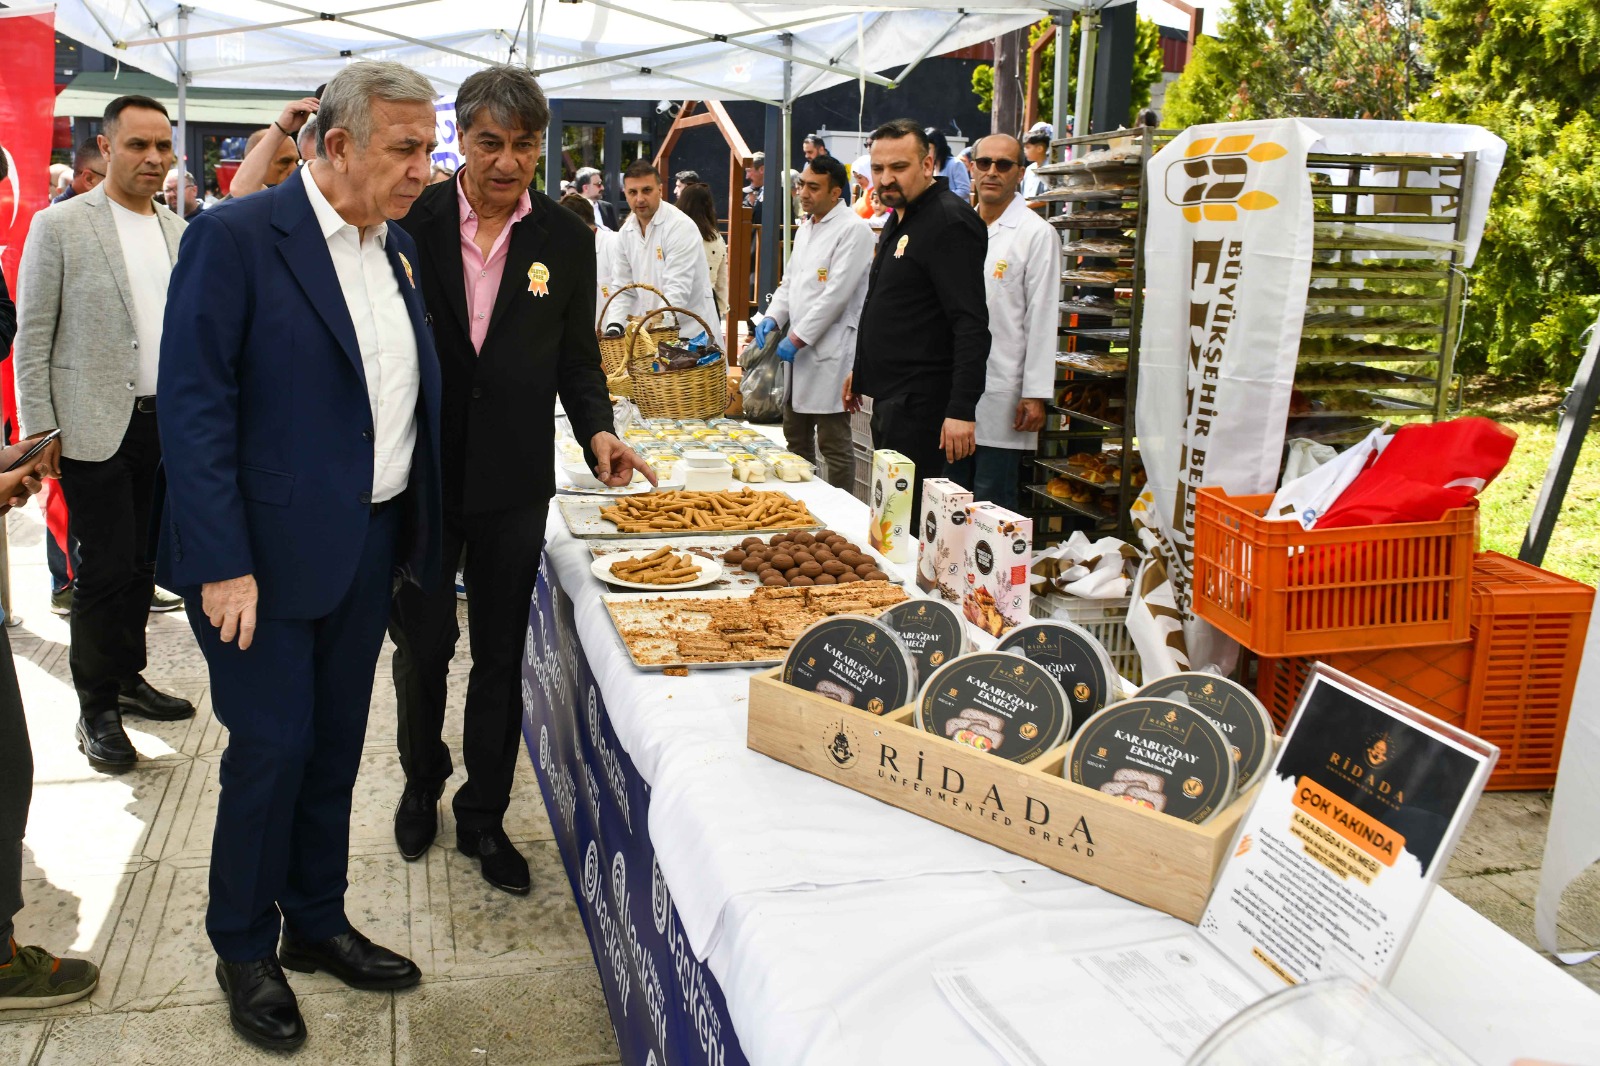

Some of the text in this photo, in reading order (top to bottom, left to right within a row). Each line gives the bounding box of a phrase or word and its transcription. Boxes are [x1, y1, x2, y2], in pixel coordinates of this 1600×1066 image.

[1194, 240, 1243, 436] BÜYÜKŞEHİR
[823, 643, 886, 686] KARABUĞDAY
[966, 675, 1038, 712] KARABUĞDAY
[1114, 730, 1200, 764] KARABUĞDAY
[1329, 752, 1404, 804] RİDADA
[878, 743, 1096, 846] RİDADA
[878, 769, 1096, 858] UNFERMENTED BREAD
[1300, 787, 1392, 856] ÇOK YAKINDA
[1294, 813, 1380, 872] KARABUĞDAY EKMEĞİ
[595, 874, 630, 1017] başkent
[622, 892, 668, 1066] başkent
[696, 966, 722, 1036] MARKET
